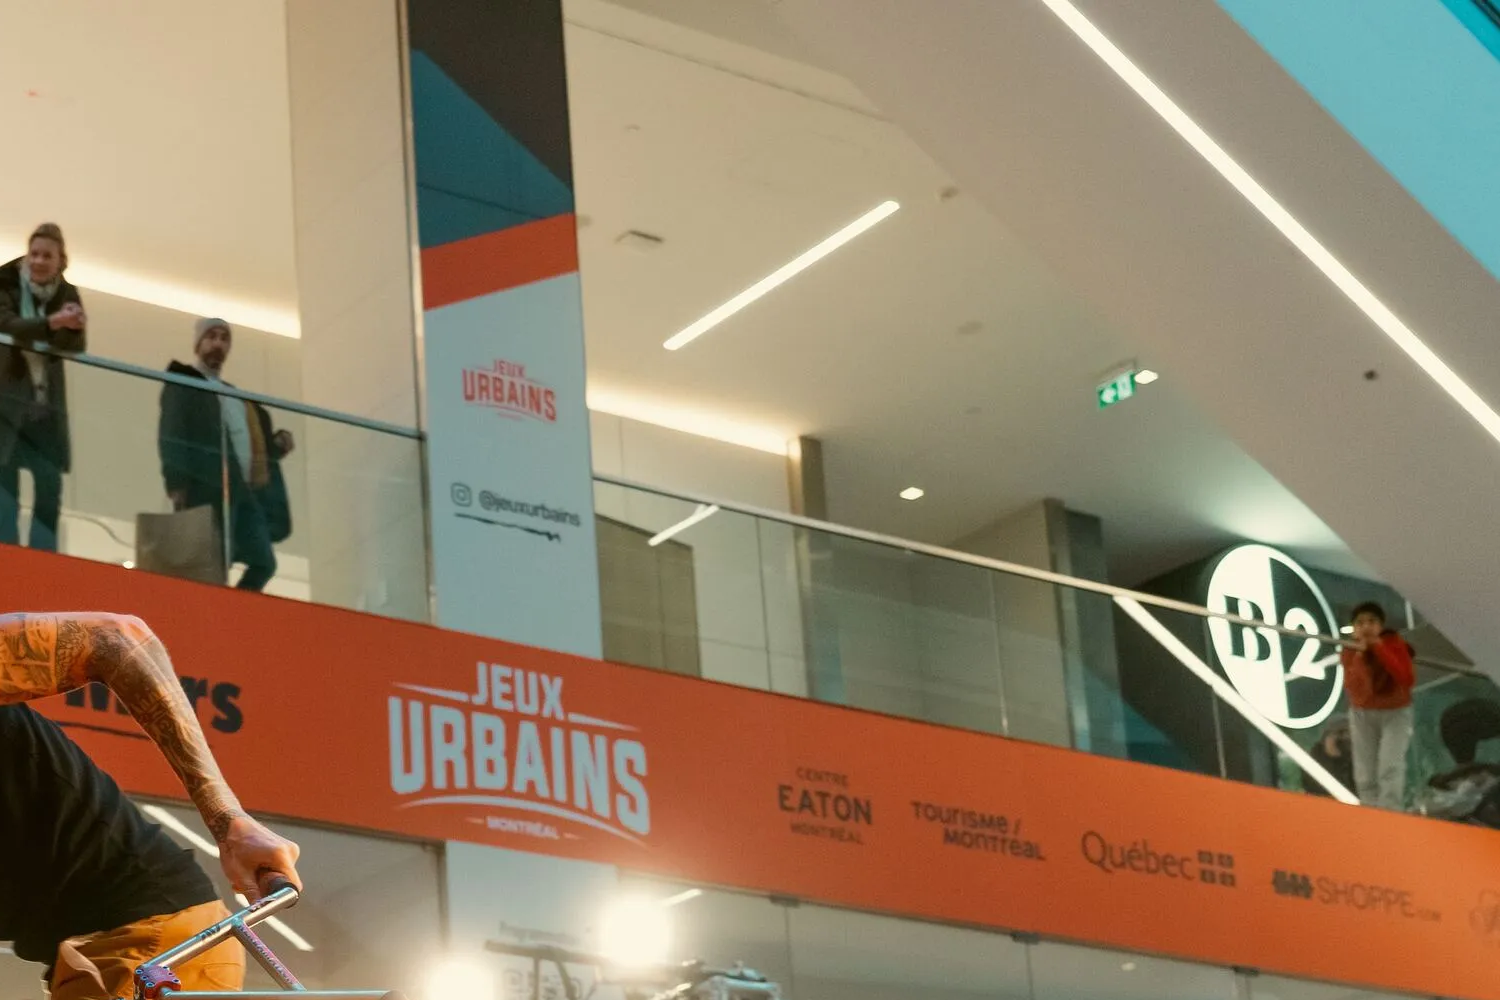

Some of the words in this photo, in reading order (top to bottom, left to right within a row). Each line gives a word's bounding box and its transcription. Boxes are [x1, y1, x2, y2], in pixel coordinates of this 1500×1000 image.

[462, 368, 557, 422] URBAINS
[1224, 594, 1326, 681] B2
[472, 661, 565, 721] JEUX
[387, 695, 651, 836] URBAINS
[795, 766, 849, 789] CENTRE
[777, 783, 872, 826] EATON
[1080, 829, 1196, 882] Québec
